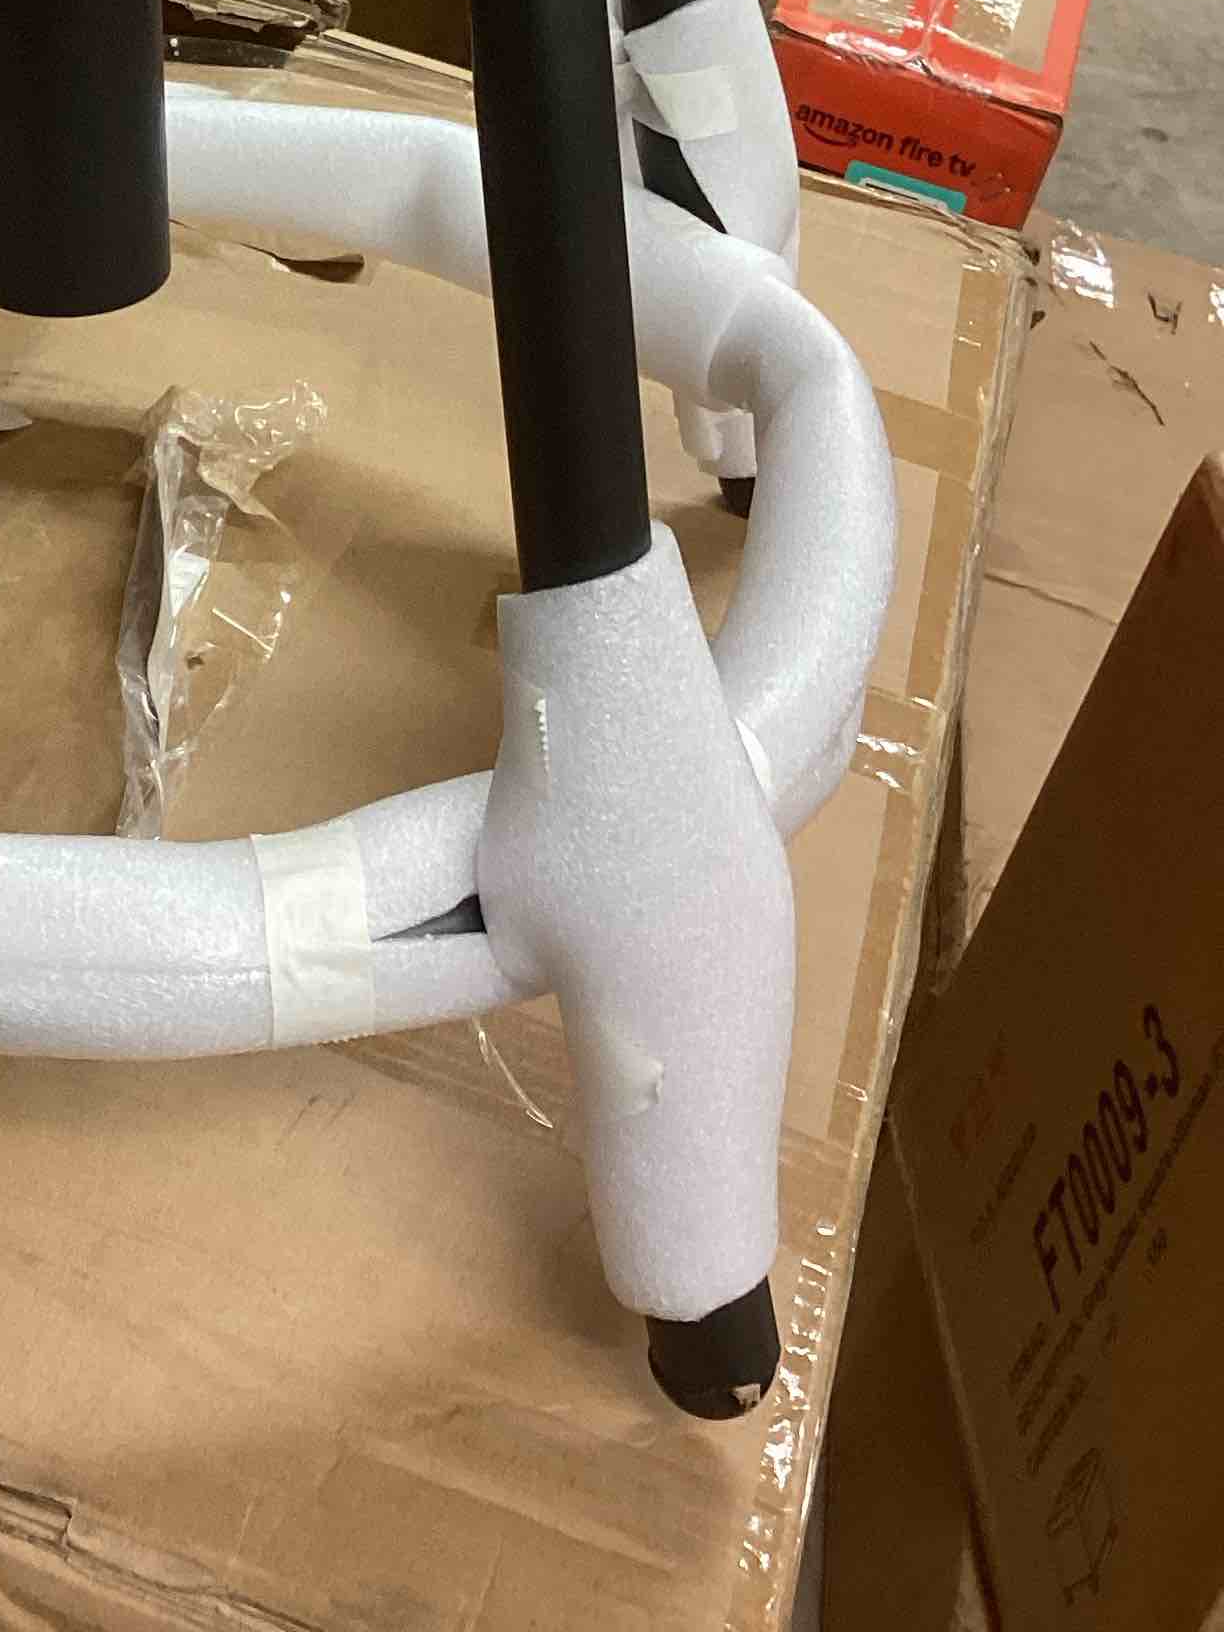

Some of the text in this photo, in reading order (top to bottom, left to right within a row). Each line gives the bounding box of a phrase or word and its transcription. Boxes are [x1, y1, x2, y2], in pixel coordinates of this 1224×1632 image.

[795, 103, 977, 177] amazon fire tv
